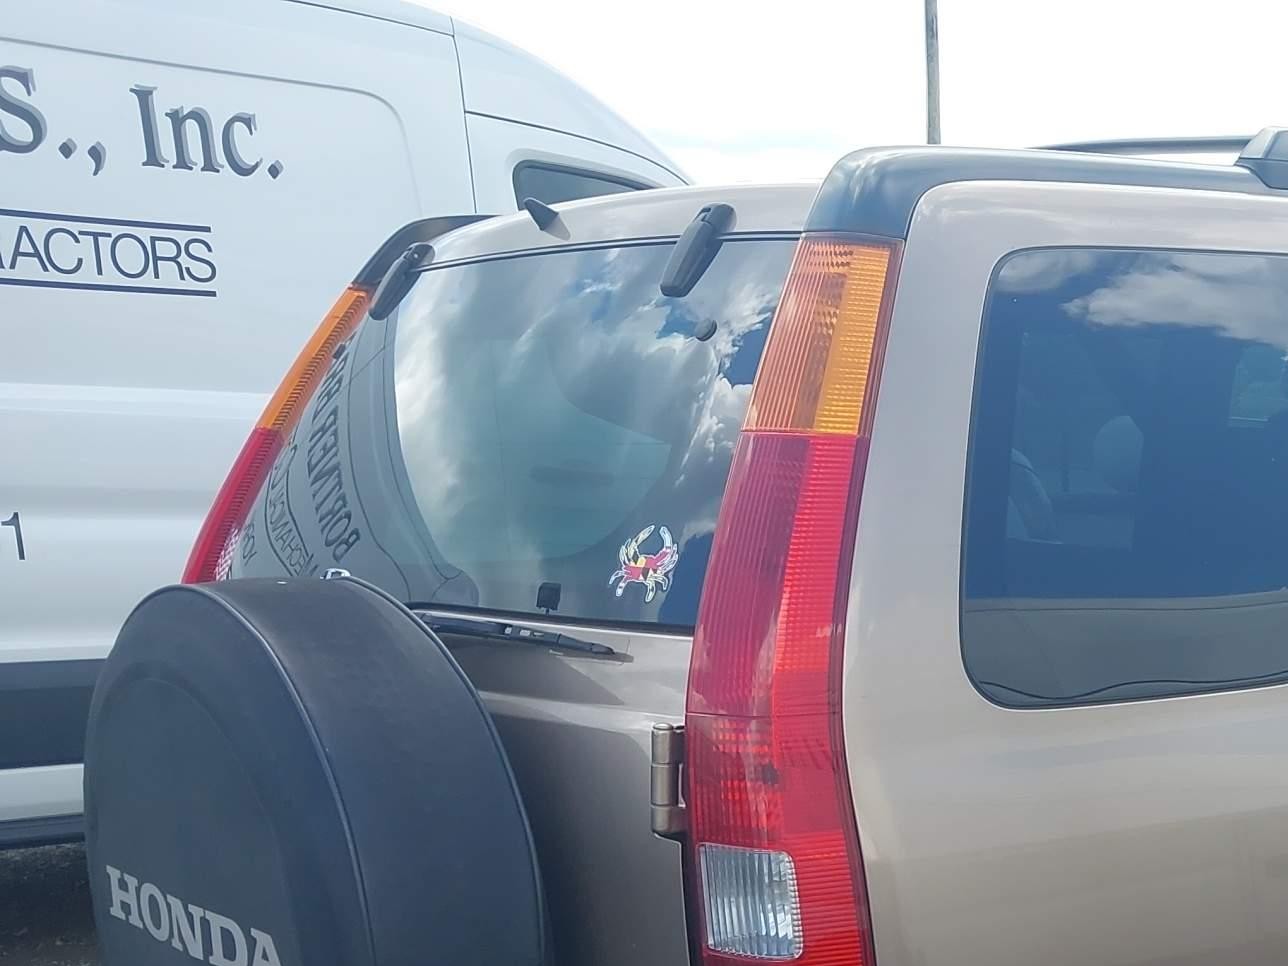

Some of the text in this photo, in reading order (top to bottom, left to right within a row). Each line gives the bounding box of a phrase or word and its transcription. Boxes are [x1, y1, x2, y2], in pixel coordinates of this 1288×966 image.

[129, 84, 284, 180] Inc.
[0, 225, 217, 283] ACTORS
[1, 511, 26, 561] 1
